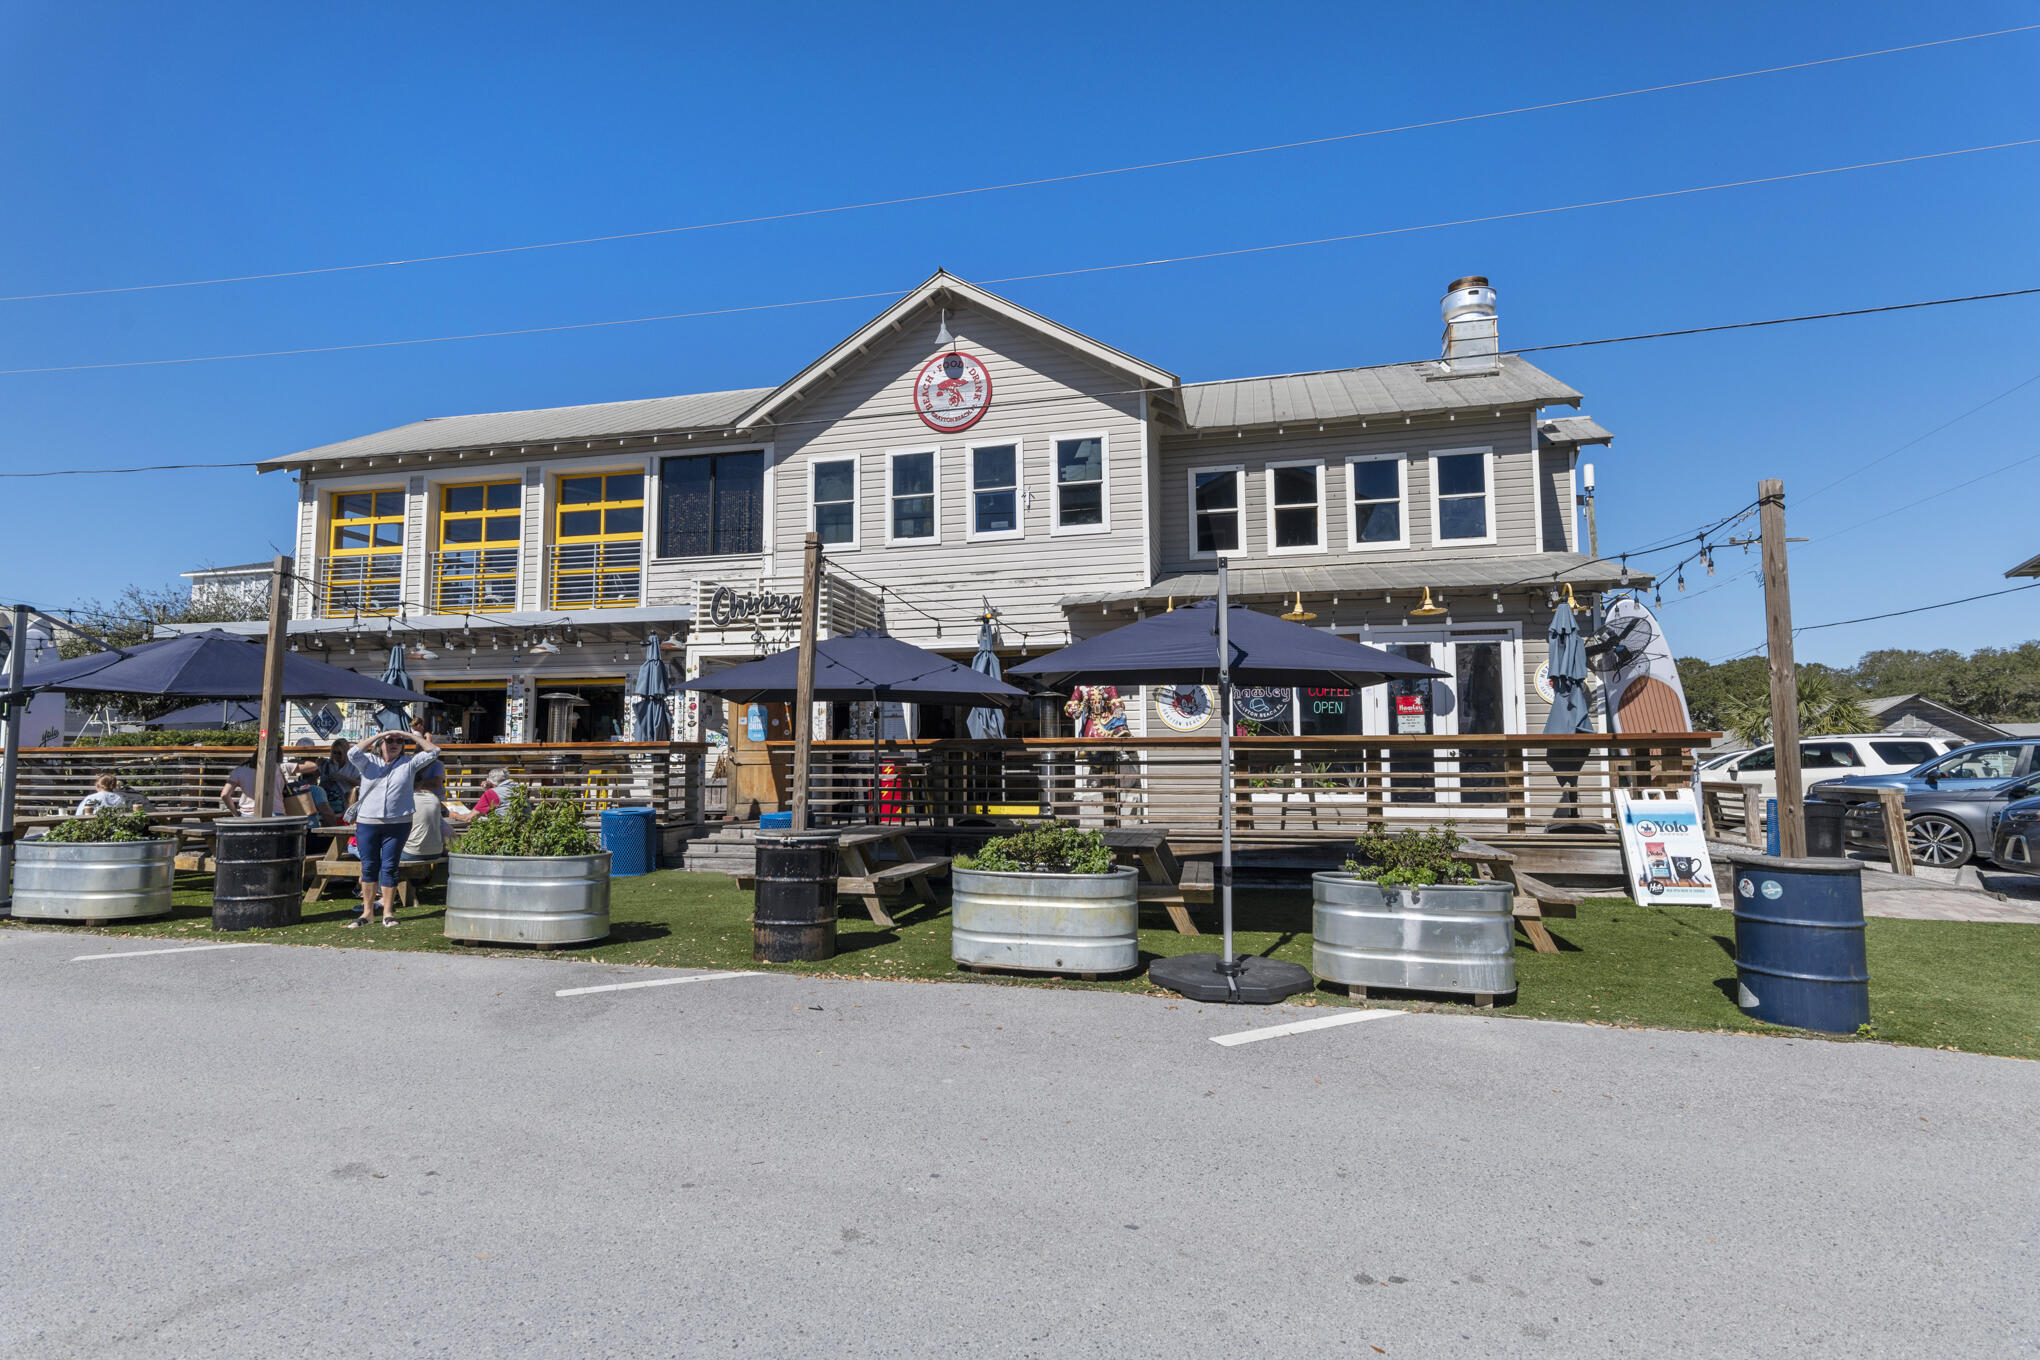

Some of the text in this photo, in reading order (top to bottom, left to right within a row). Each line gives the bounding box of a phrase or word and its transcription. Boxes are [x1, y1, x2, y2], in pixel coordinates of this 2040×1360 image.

[921, 360, 983, 411] BEACH FOOD DRINK
[710, 586, 803, 627] Chiringo
[1313, 701, 1343, 714] OPEN
[1654, 820, 1689, 833] Yolo
